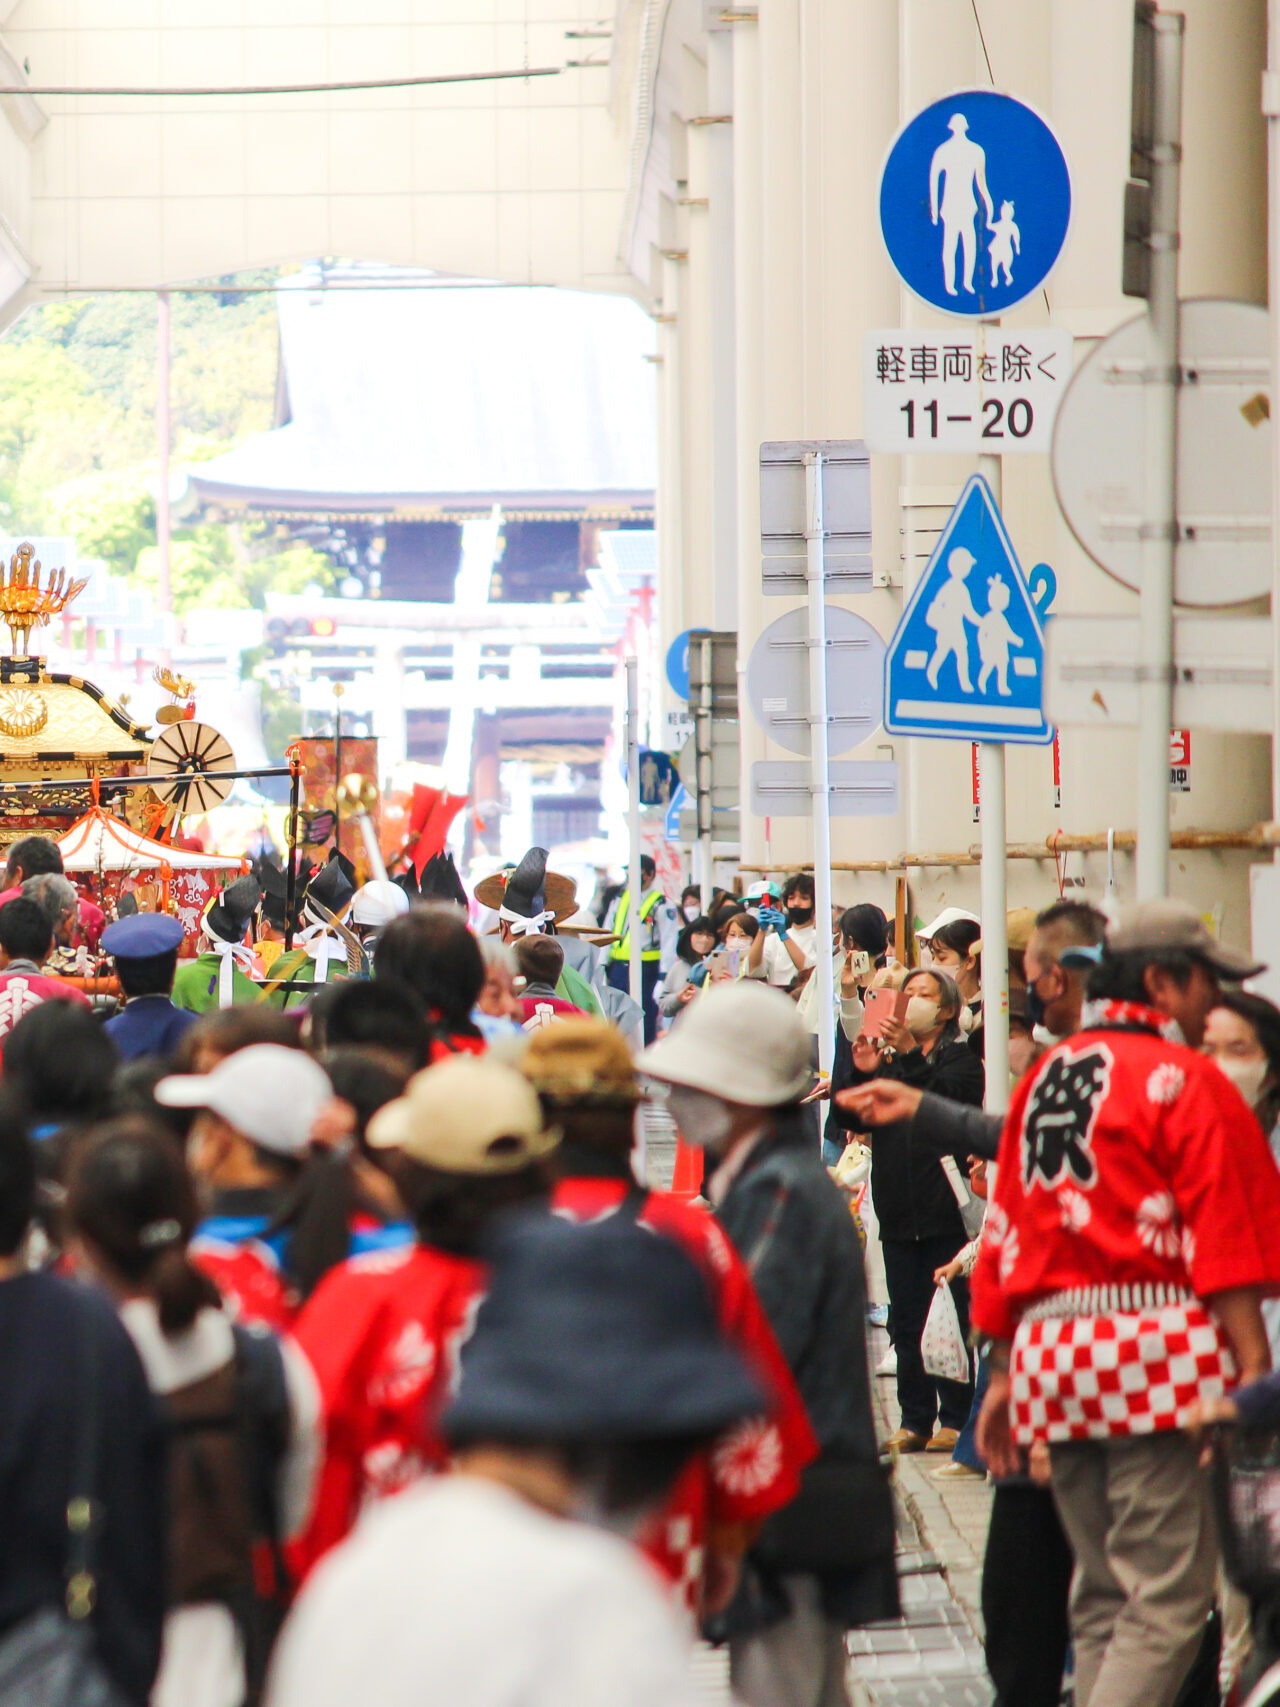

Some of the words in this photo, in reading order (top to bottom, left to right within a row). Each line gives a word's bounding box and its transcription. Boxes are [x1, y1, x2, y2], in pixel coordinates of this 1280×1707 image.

[876, 344, 1057, 385] 軽車両を除く
[900, 397, 1034, 439] 11-20
[1024, 1049, 1108, 1183] 祭
